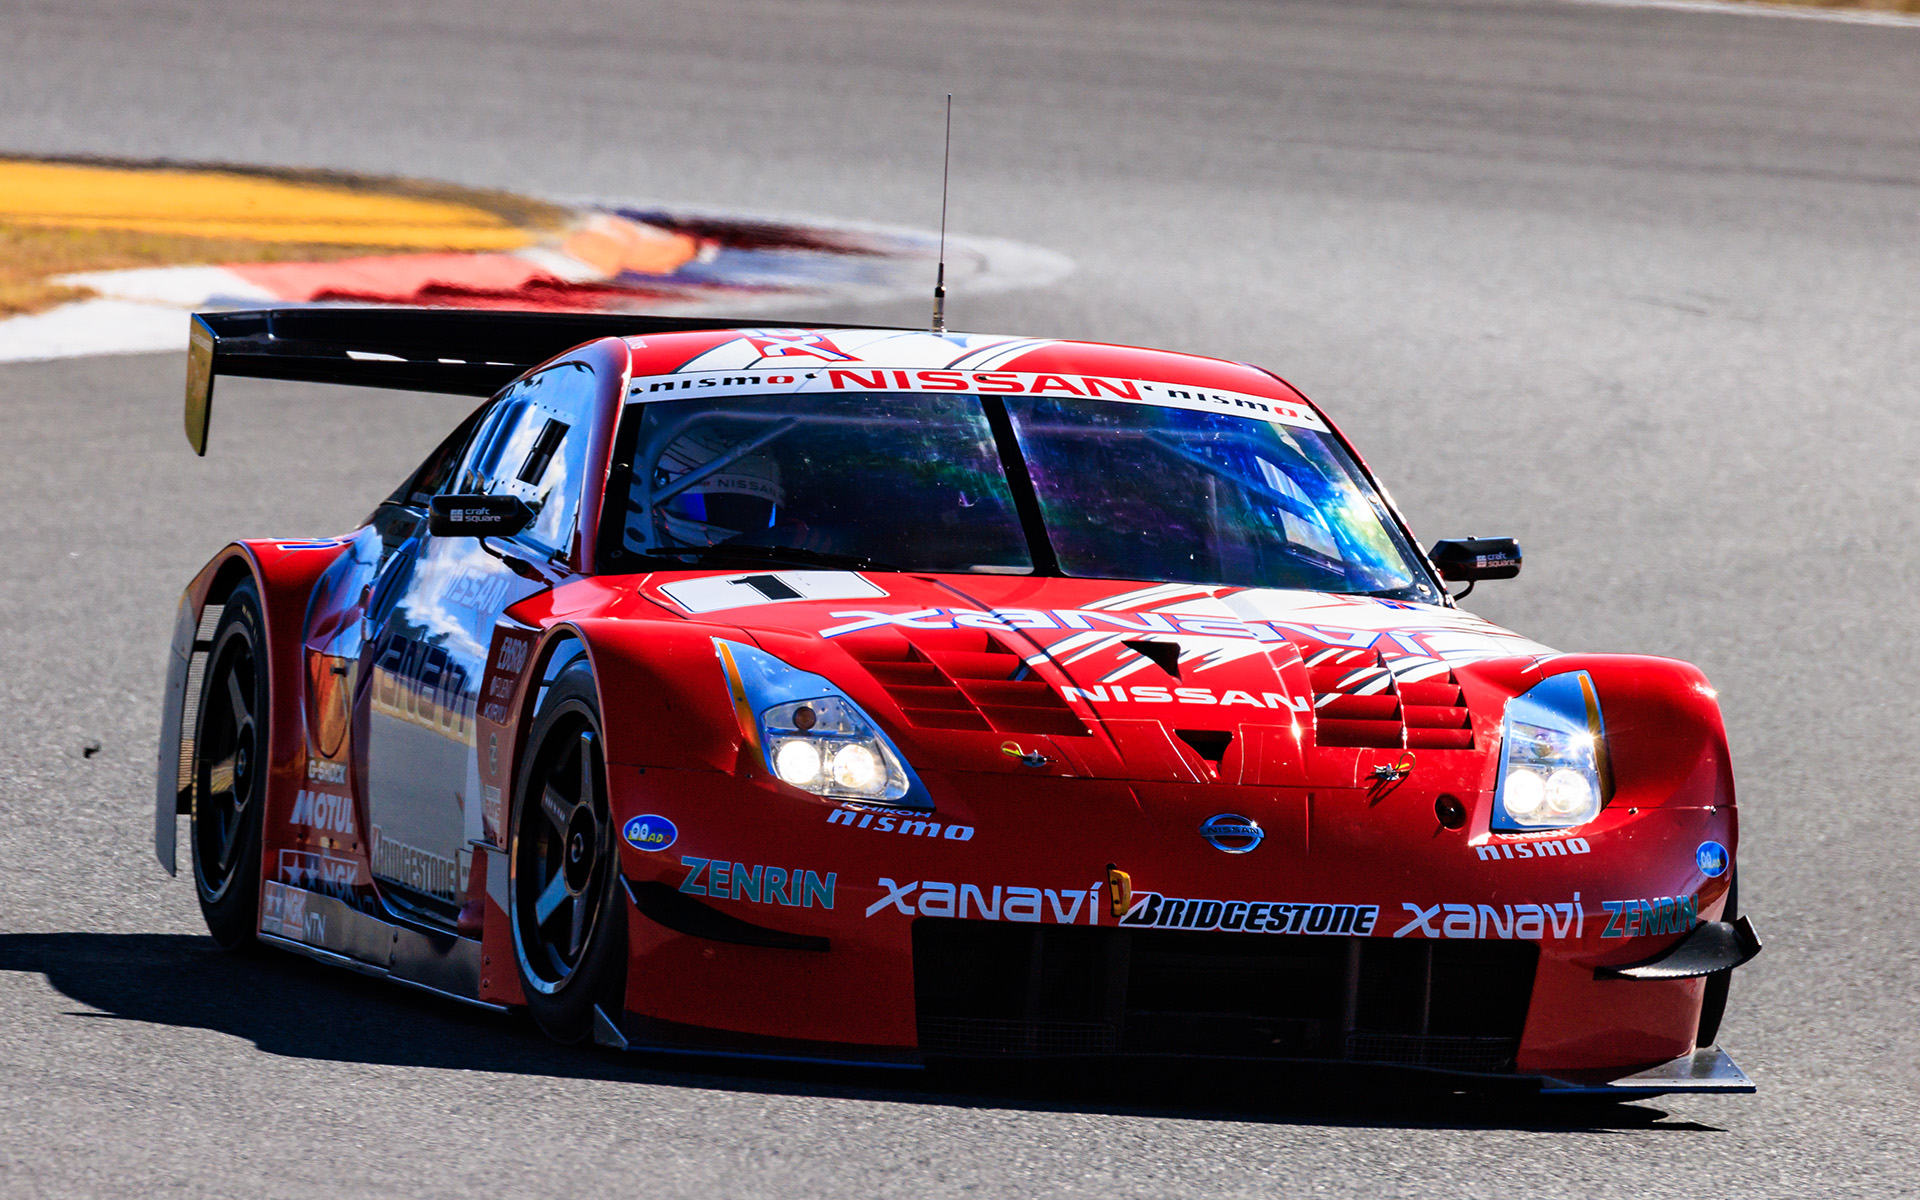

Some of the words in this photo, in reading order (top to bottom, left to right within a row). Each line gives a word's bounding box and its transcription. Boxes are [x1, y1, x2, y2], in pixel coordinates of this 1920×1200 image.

[649, 374, 795, 393] nismo
[827, 370, 1144, 401] NISSAN
[1167, 389, 1298, 418] nismo
[464, 507, 490, 515] craft
[465, 515, 501, 523] square
[1487, 551, 1507, 560] craft
[1488, 559, 1516, 568] square
[441, 562, 511, 615] NISSAN
[726, 573, 808, 601] 1
[1060, 685, 1312, 712] NISSAN
[290, 789, 353, 834] MOTUL
[840, 801, 932, 818] ICHIKOH
[826, 808, 975, 841] nismo
[1207, 826, 1260, 835] NISSAN
[1475, 837, 1591, 861] nismo
[322, 861, 358, 903] NGK
[678, 855, 838, 910] ZENRIN
[1118, 890, 1380, 937] BRIDGESTONE
[1600, 893, 1699, 940] ZENRIN
